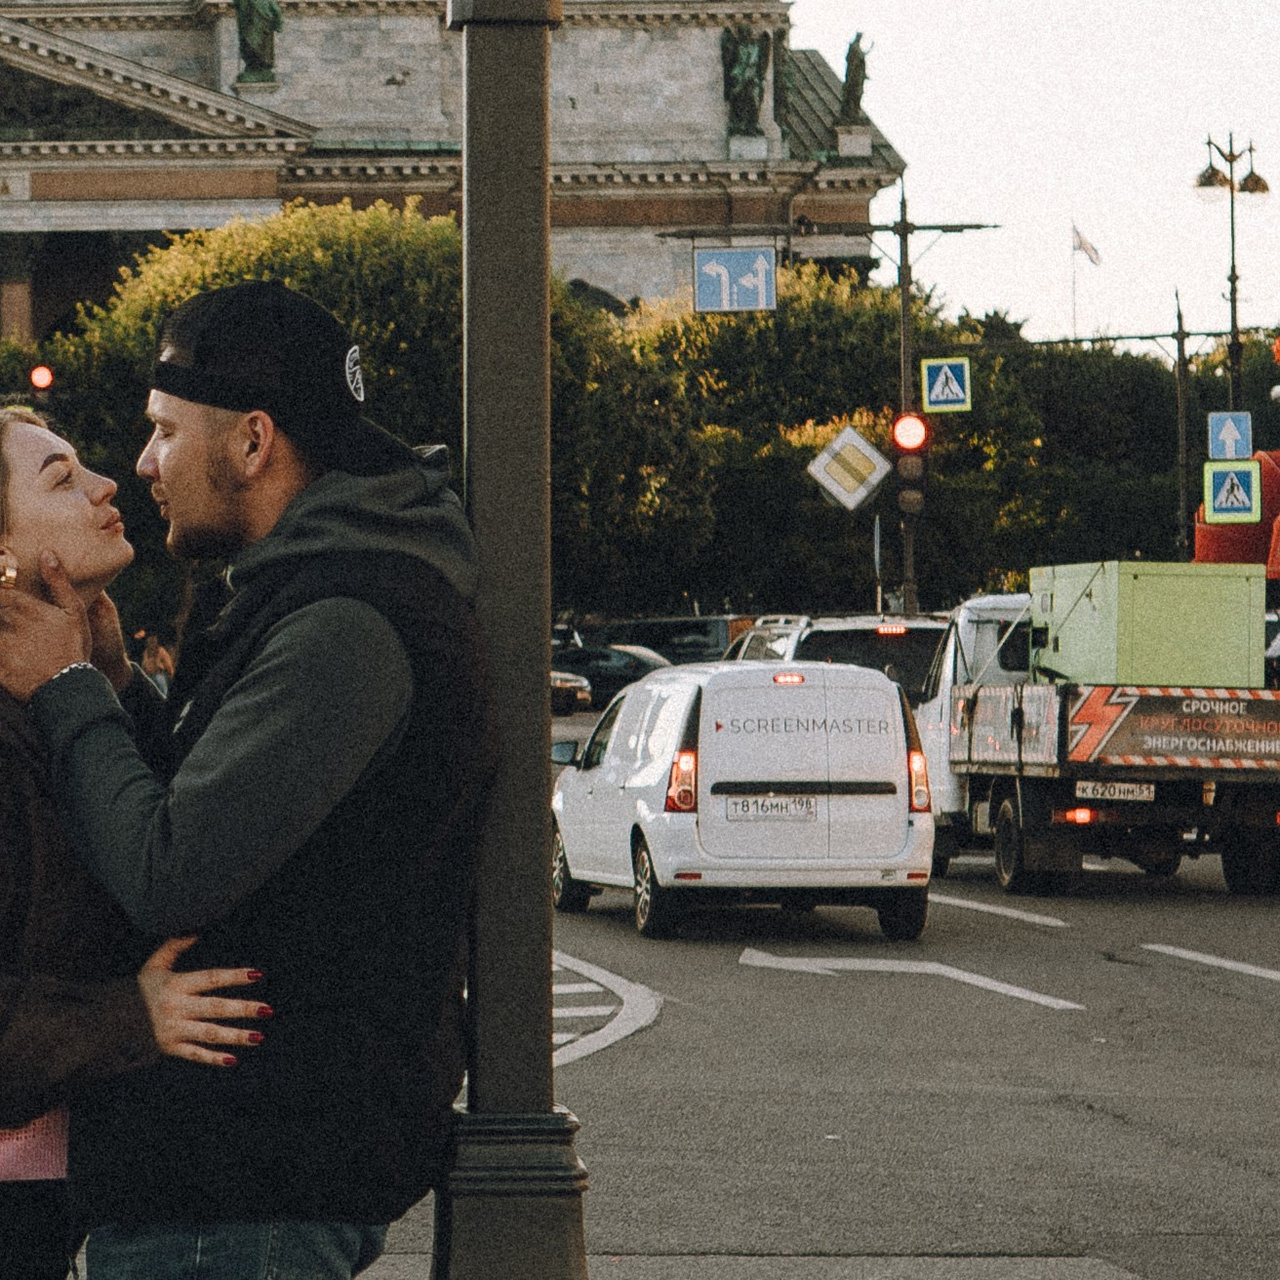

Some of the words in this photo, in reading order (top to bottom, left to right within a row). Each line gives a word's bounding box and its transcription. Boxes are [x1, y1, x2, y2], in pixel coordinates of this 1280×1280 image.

[1182, 700, 1248, 715] СРОЧНОЕ
[730, 718, 889, 734] SCREENMASTER
[1140, 716, 1280, 734] КРУГЛОСУТОЧНО
